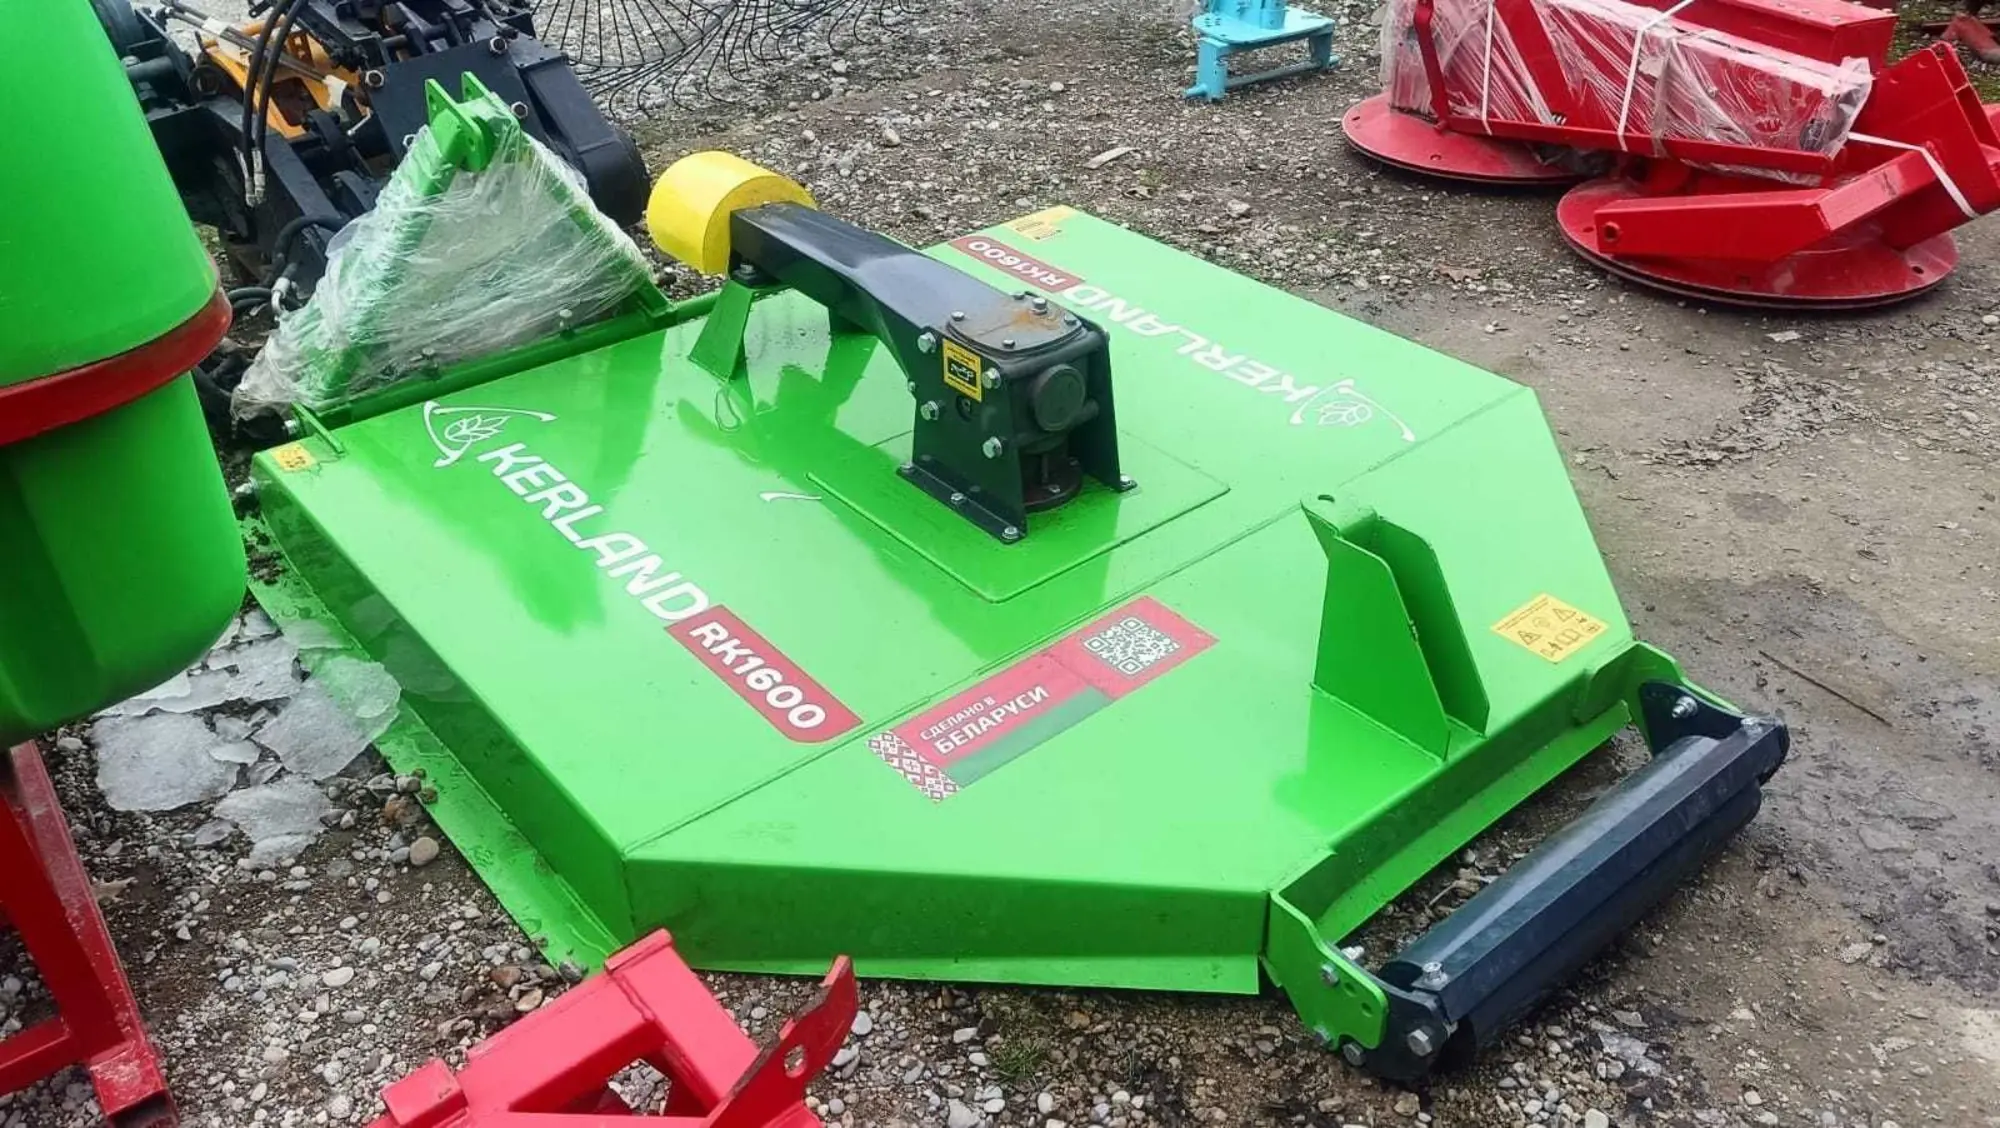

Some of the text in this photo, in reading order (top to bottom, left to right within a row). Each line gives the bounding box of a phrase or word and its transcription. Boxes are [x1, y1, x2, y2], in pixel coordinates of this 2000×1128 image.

[968, 240, 1318, 401] KERLAND RK1600
[477, 443, 826, 729] KERLAND RK1600
[919, 702, 985, 741] СДЕЛАНО
[934, 685, 1049, 755] БЕЛАРУСИ
